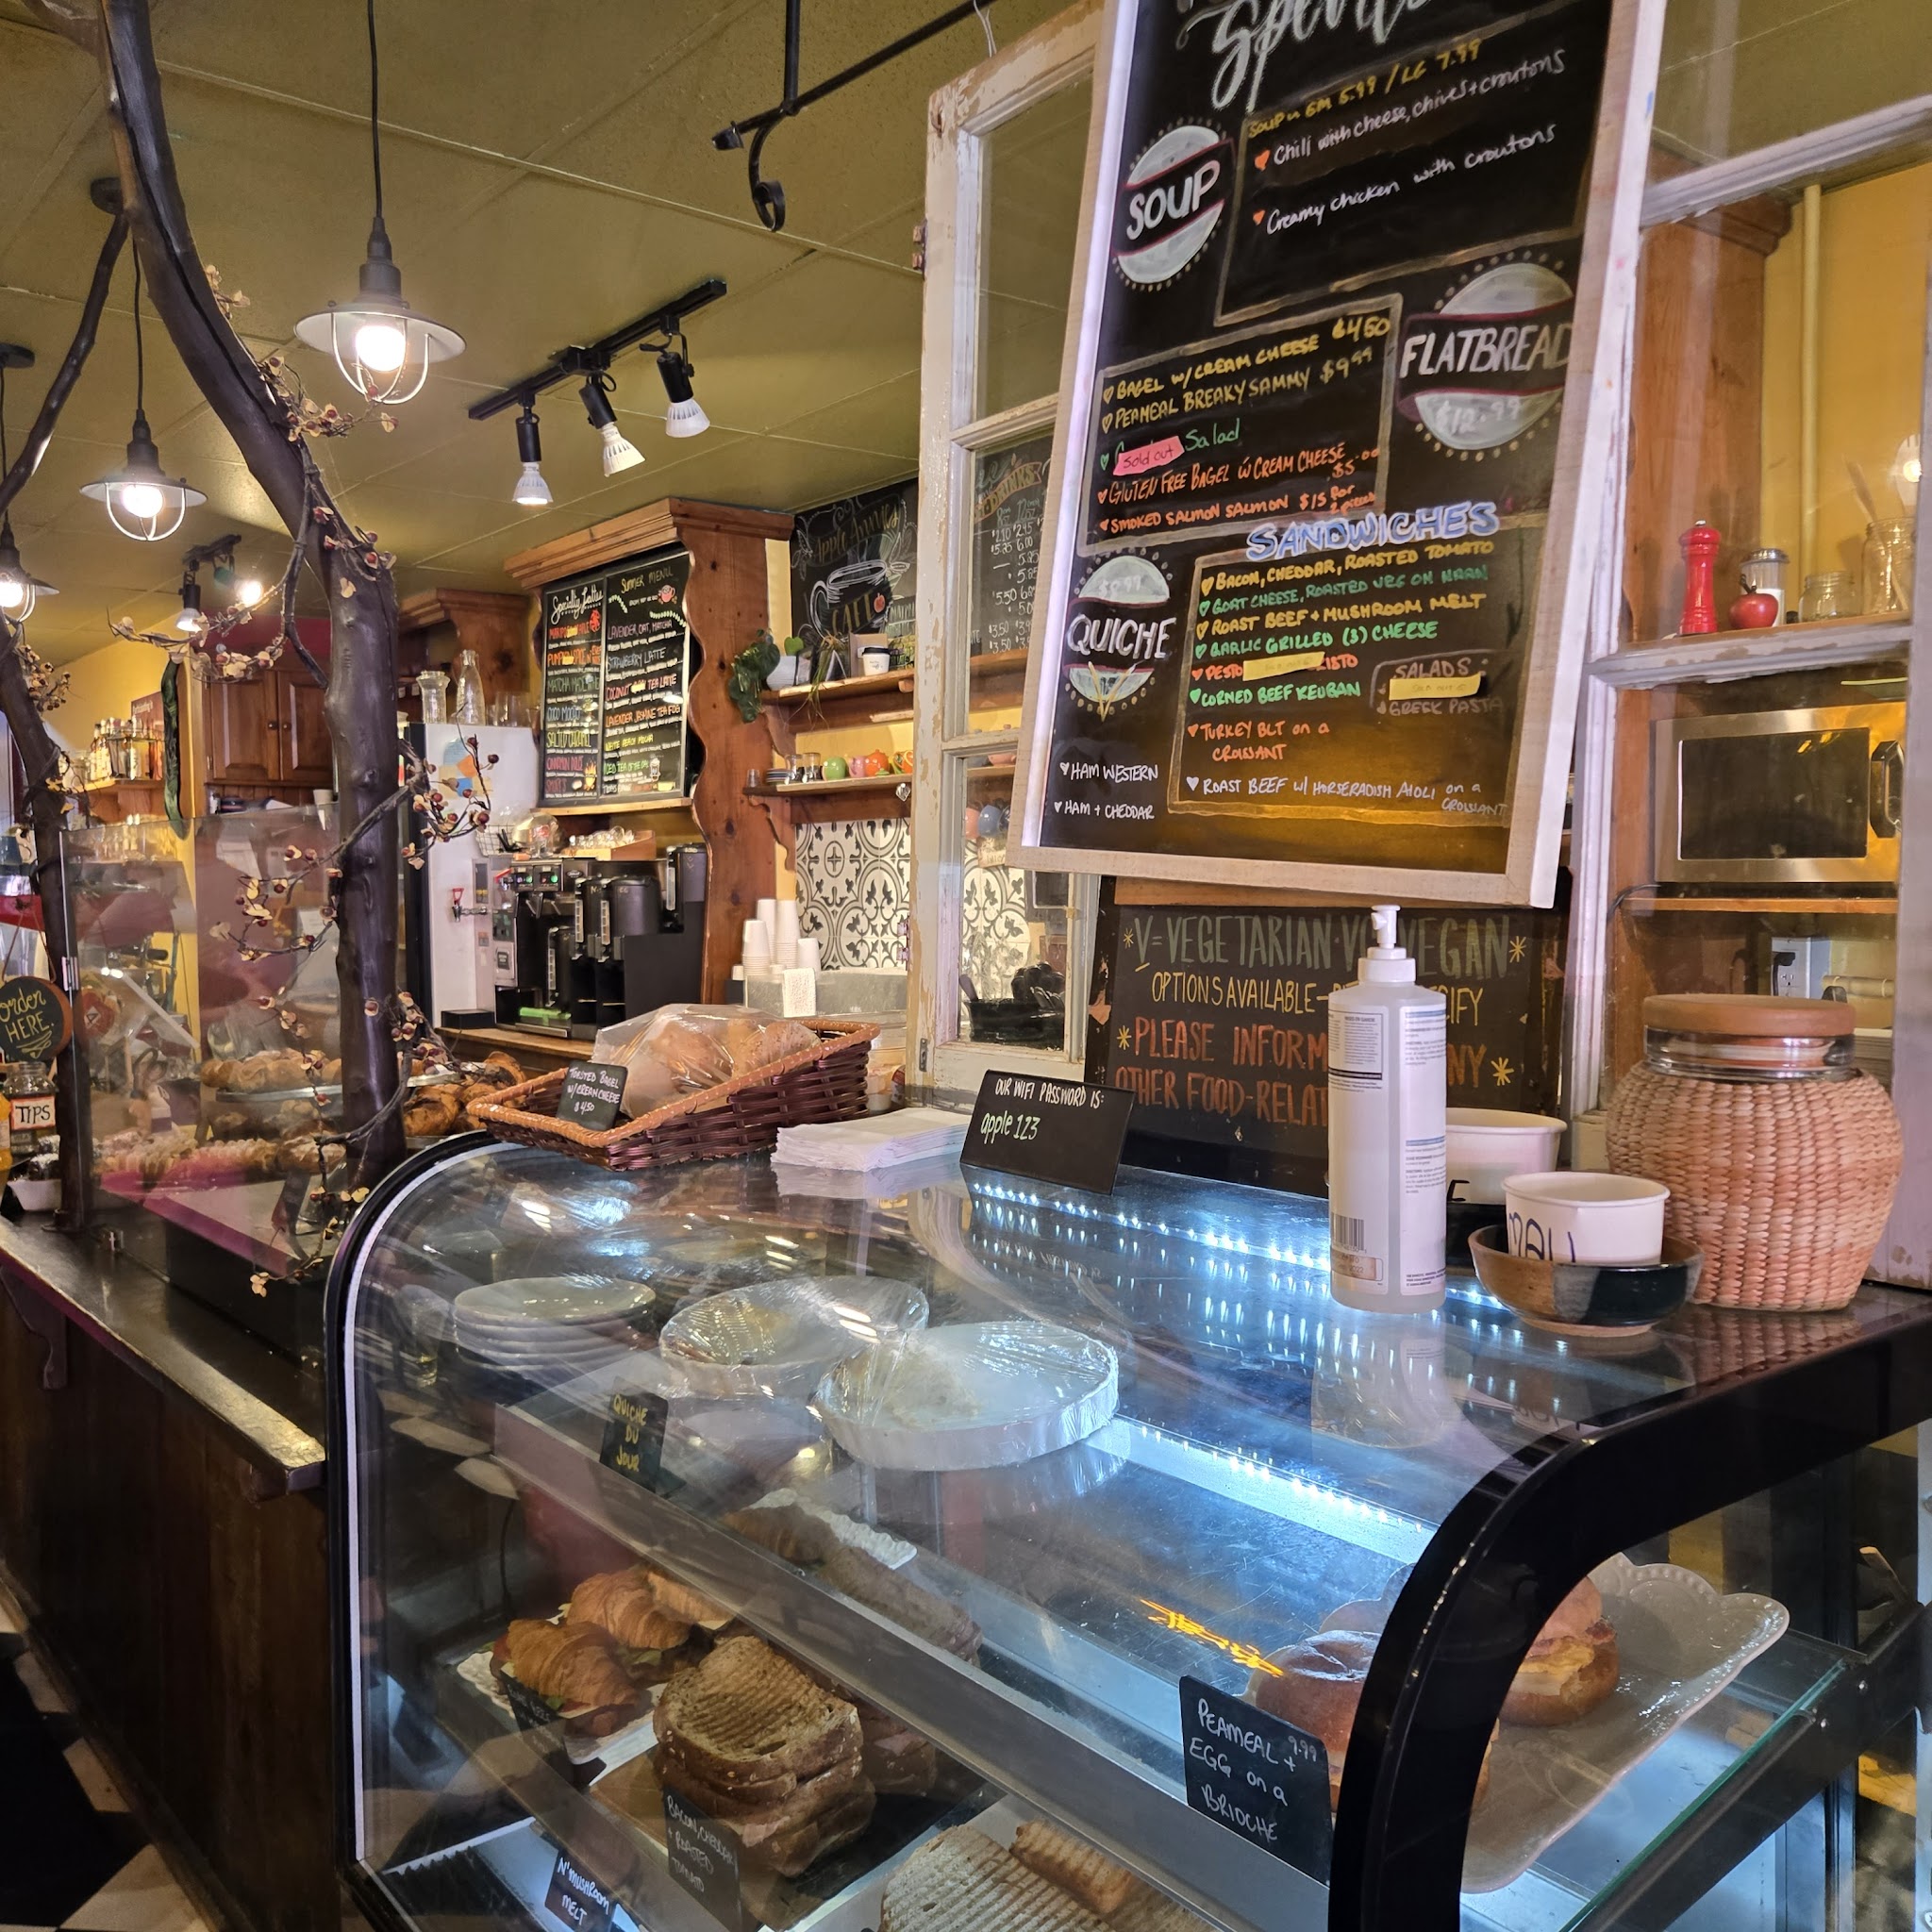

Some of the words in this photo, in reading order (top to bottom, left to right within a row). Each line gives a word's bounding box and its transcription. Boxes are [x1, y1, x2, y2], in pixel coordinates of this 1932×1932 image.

[1273, 135, 1312, 166] Chili
[1317, 125, 1352, 151] with
[1266, 204, 1325, 236] Creamy
[1329, 180, 1402, 212] chicken
[1412, 158, 1457, 184] with
[1464, 124, 1557, 170] croutons
[1125, 159, 1221, 241] SOUP
[1116, 377, 1166, 400] BAGEL
[1255, 333, 1321, 365] CHEESE
[1113, 397, 1179, 430] PEAMEAL
[1182, 378, 1248, 413] BREAKY
[1247, 365, 1312, 398] SAMMY
[1153, 444, 1174, 461] out
[1184, 416, 1241, 453] Salad
[1160, 468, 1189, 494] FREE
[1191, 461, 1230, 491] BAGEL
[1296, 441, 1346, 474] CHEESE
[1110, 511, 1162, 534] SMOKED
[1165, 502, 1222, 526] SALMON
[1224, 493, 1290, 519] SALMON
[1298, 491, 1328, 511] $15
[1245, 500, 1500, 562] SANDWICHES
[1344, 550, 1419, 571] ROASTED
[1424, 540, 1495, 561] TOMATO
[1211, 596, 1249, 615] GOAT
[1305, 578, 1369, 599] ROASTED
[1409, 569, 1435, 587] ON
[1210, 614, 1262, 637] ROAST
[1263, 608, 1310, 630] BEEF
[1323, 598, 1424, 624] MUSHROOM
[1429, 592, 1488, 611] MELT
[1066, 613, 1177, 659] QUICHE
[1208, 637, 1263, 658] GARLIC
[1264, 630, 1335, 656] GRILLED
[1371, 620, 1440, 642] CHEESE
[1200, 688, 1254, 708] CORNED
[1257, 683, 1294, 705] BEEF
[1448, 697, 1504, 716] PASTA
[1199, 720, 1253, 741] TURKEY
[1257, 720, 1287, 739] BLT
[1291, 722, 1311, 736] on
[1317, 723, 1331, 735] a
[1070, 761, 1101, 781] HAM
[1102, 763, 1159, 784] WESTERN
[1202, 777, 1242, 795] ROAST
[1247, 775, 1290, 795] BEEF
[1311, 781, 1392, 799] HORSERADISH
[1445, 783, 1465, 795] on
[1471, 783, 1482, 793] a
[1063, 798, 1091, 817] HAM
[1104, 803, 1156, 821] CHEDDAR
[1151, 970, 1224, 1008] OPTIONS
[1134, 1015, 1216, 1062] PLEASE
[1232, 1023, 1329, 1073] INFORM
[994, 1077, 1013, 1096] OUR
[1012, 1079, 1036, 1101] WIFI
[1039, 1081, 1087, 1108] PASSWORD
[1114, 1065, 1180, 1110] OTHER
[14, 1104, 52, 1124] TIPS
[612, 1393, 649, 1427] QUICHE
[625, 1424, 641, 1445] DU
[615, 1444, 641, 1473] JOUR
[1197, 1697, 1280, 1765] PEAMEAL
[1287, 1734, 1318, 1763] 9.99
[1188, 1736, 1232, 1778] EGG
[1245, 1770, 1268, 1793] on
[1273, 1786, 1289, 1807] a
[1200, 1783, 1279, 1843] BRIOCHE
[561, 1893, 588, 1926] MELT
